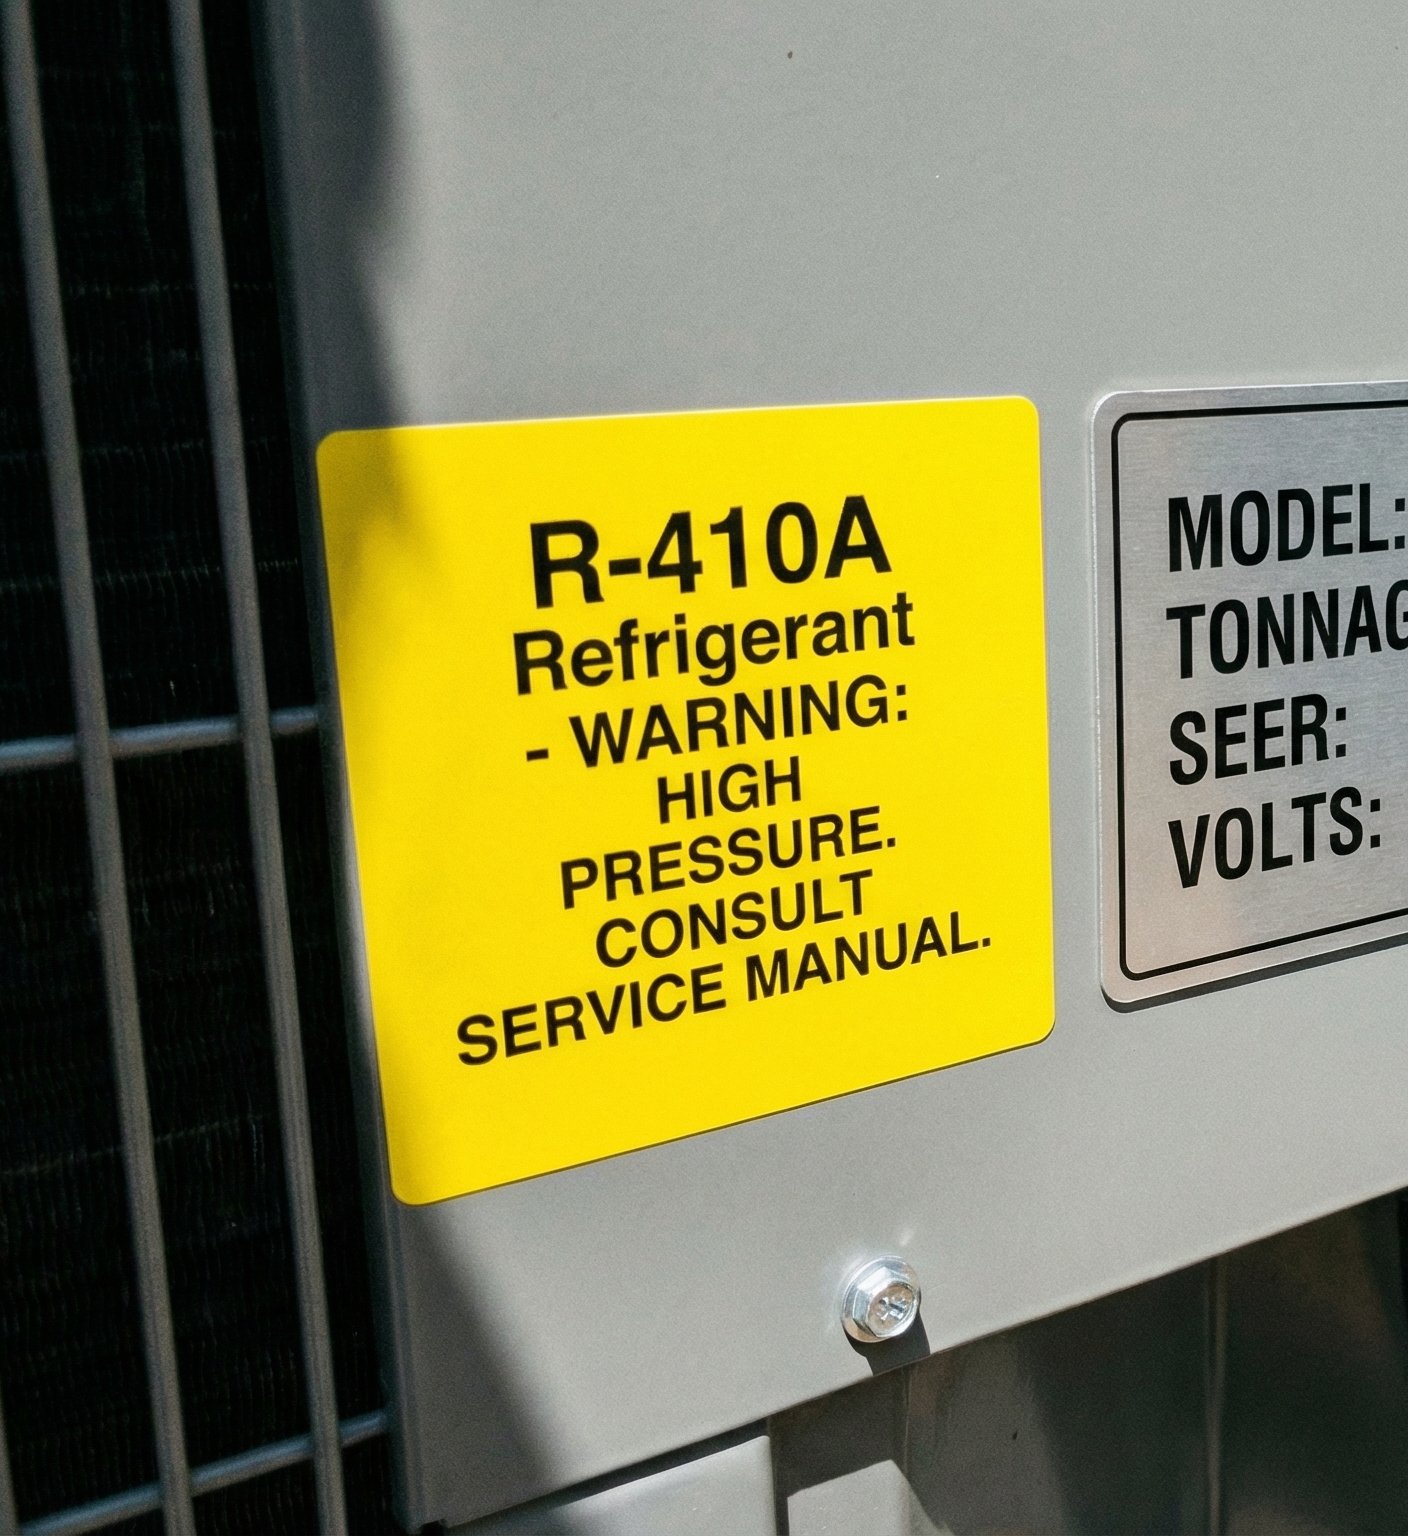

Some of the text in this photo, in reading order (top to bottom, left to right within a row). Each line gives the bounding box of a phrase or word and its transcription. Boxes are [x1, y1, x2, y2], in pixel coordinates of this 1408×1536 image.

[530, 495, 891, 609] R-410A
[1168, 482, 1406, 573] MODEL:
[513, 592, 915, 695] Refrigerant
[569, 674, 907, 768] WARNING:
[1169, 693, 1347, 786] SEER:
[657, 756, 801, 824] HIGH
[1167, 786, 1381, 889] VOLTS:
[561, 806, 896, 909] PRESSURE.
[596, 869, 872, 968] CONSULT
[457, 911, 990, 1065] SERVICE MANUAL.
